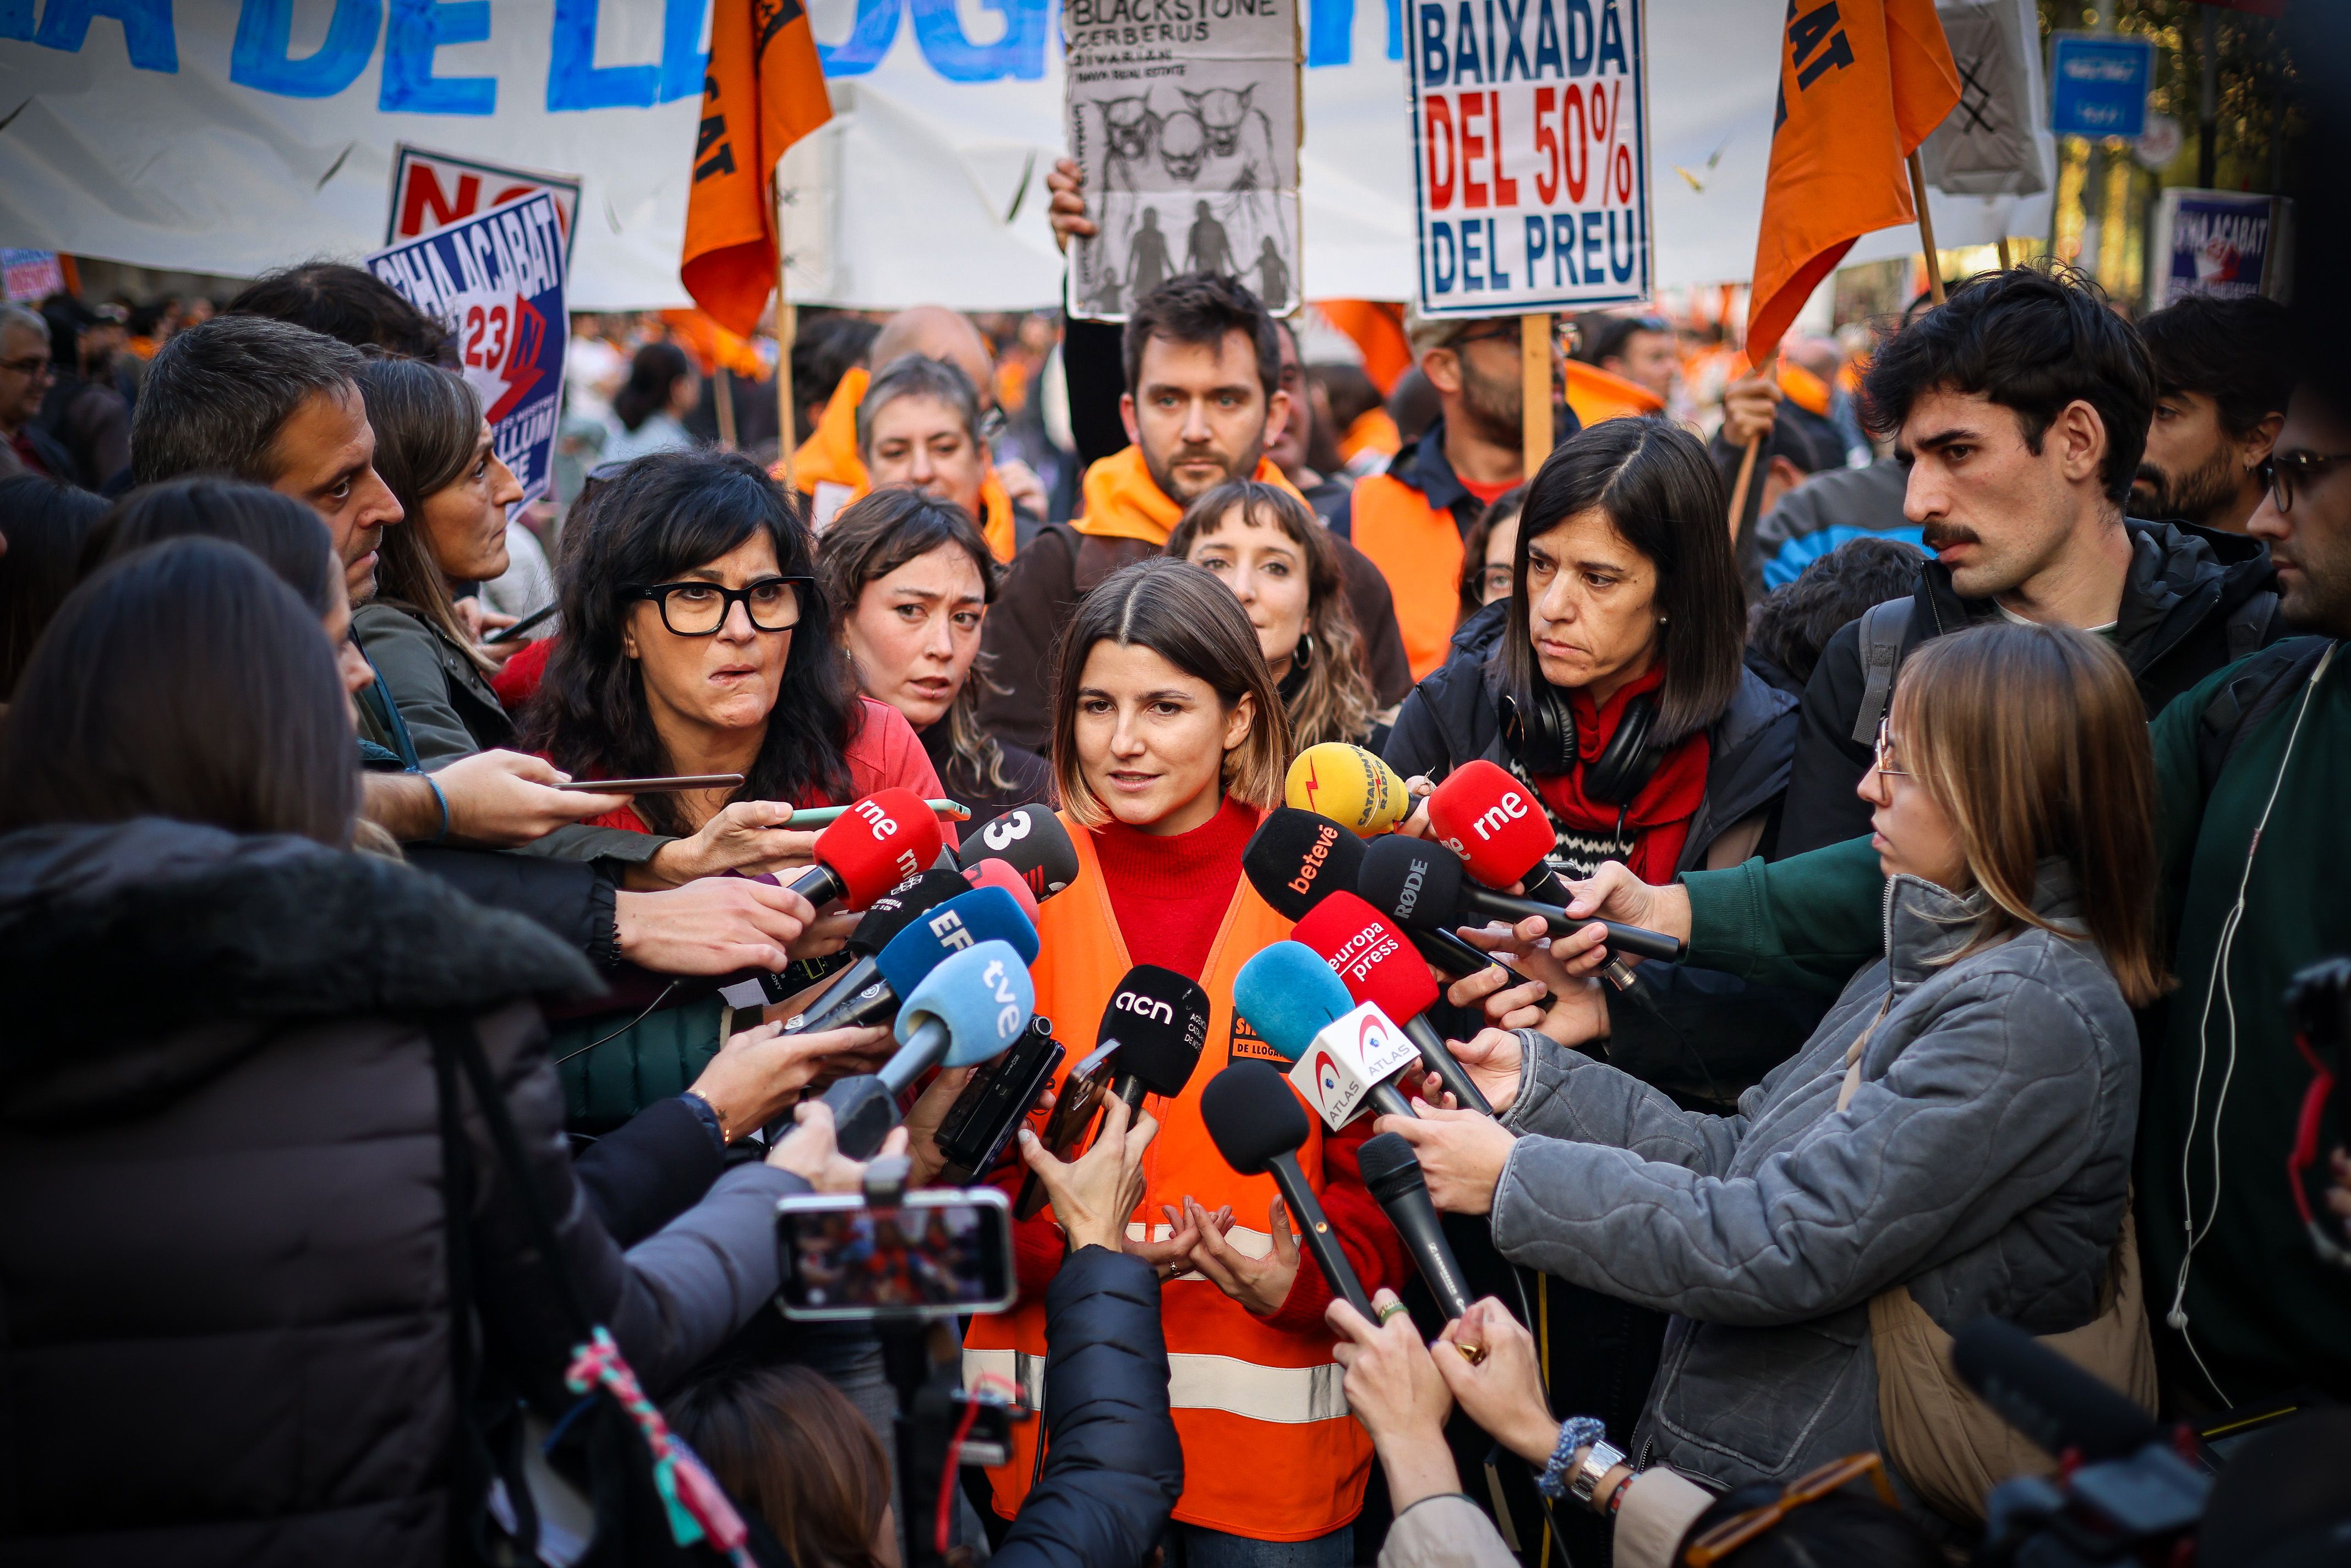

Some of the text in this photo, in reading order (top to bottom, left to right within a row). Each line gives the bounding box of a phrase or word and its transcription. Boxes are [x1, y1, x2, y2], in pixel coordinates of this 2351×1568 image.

[1073, 0, 1278, 26] BLACKSTONE
[1074, 21, 1210, 48] CERBERUS
[1421, 0, 1628, 88] BAIXADA
[1425, 79, 1631, 210] DEL 50%
[451, 198, 559, 302] ACABAT
[1433, 209, 1634, 294] DEL PREU
[466, 305, 507, 371] 23
[1350, 745, 1375, 826] CATALUNYA
[854, 800, 898, 840] rne
[983, 810, 1031, 851] 3
[1473, 792, 1528, 840] rne
[896, 848, 919, 881] rn
[1287, 824, 1339, 895] betevé
[1439, 837, 1471, 860] ne
[1393, 858, 1428, 919] RØDE
[928, 909, 975, 951] EF
[1328, 922, 1385, 970] europa
[770, 973, 783, 990] ONY
[1352, 939, 1399, 982] press
[982, 959, 1021, 1039] tve
[1116, 992, 1173, 1025] acn
[1184, 1034, 1193, 1045] DE
[1237, 1043, 1249, 1053] DE
[1368, 1044, 1410, 1077] ATLAS
[1330, 1080, 1359, 1123] ATLAS
